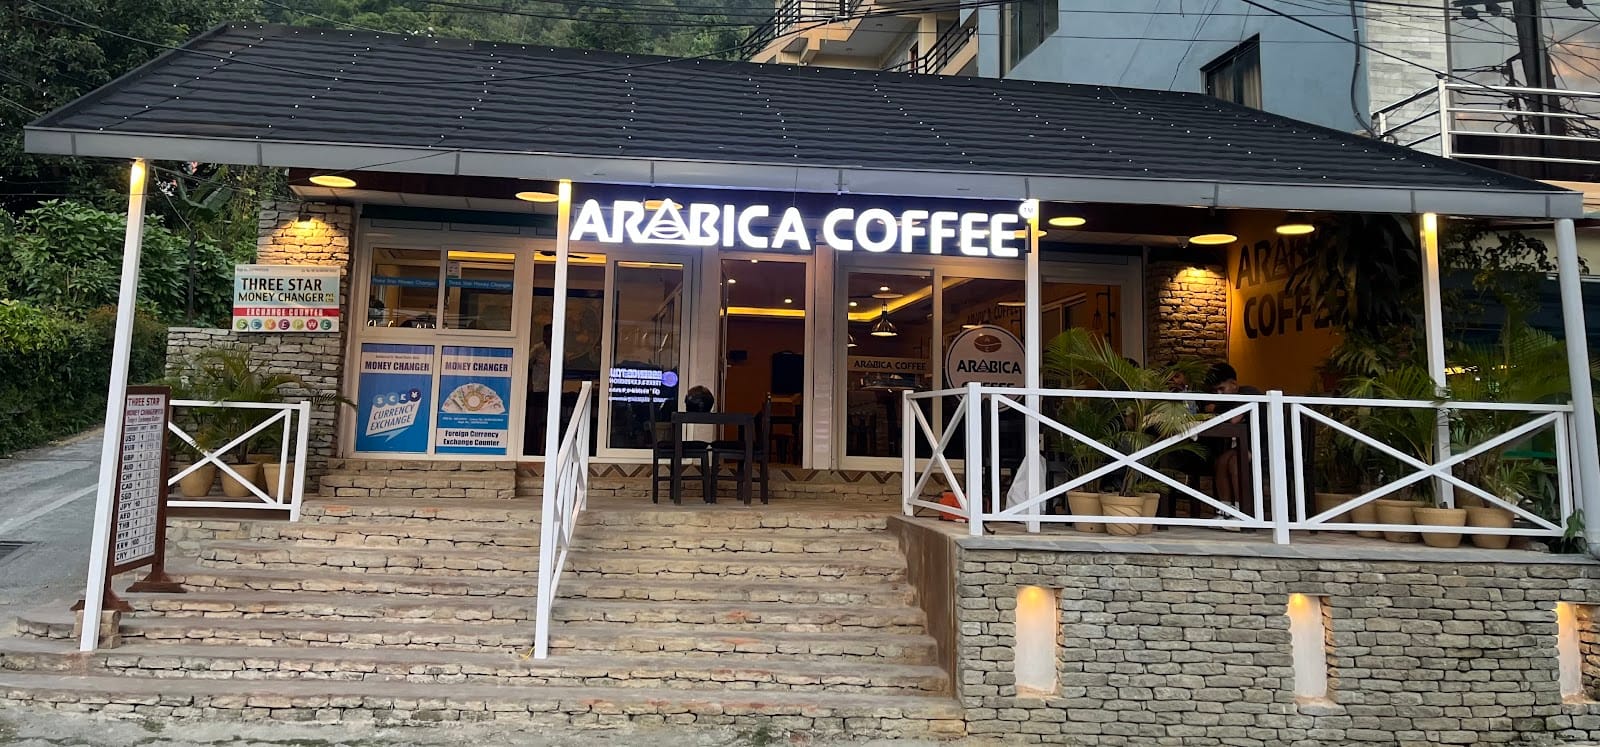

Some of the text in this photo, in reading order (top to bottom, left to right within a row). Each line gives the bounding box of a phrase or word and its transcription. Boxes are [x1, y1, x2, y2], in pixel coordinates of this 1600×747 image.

[570, 197, 811, 250] ARABICA
[823, 206, 1018, 257] COFFEE
[241, 278, 322, 291] THREE STAR
[238, 292, 324, 302] MONEY CHANGER
[246, 308, 323, 316] EXCHANGE COUNTER
[365, 361, 430, 372] MONEY CHANGER
[445, 362, 508, 372] MONEY CHANGER
[854, 360, 926, 371] ARABICA COFFEE
[957, 359, 1022, 374] ARABICA
[128, 397, 160, 407] THREE STAR
[373, 403, 415, 420] CURRENCY
[370, 414, 411, 430] EXCHANGE
[445, 430, 468, 438] Foreign
[443, 438, 499, 447] Exchange Counter
[121, 482, 132, 490] CAD
[120, 502, 132, 510] JPY
